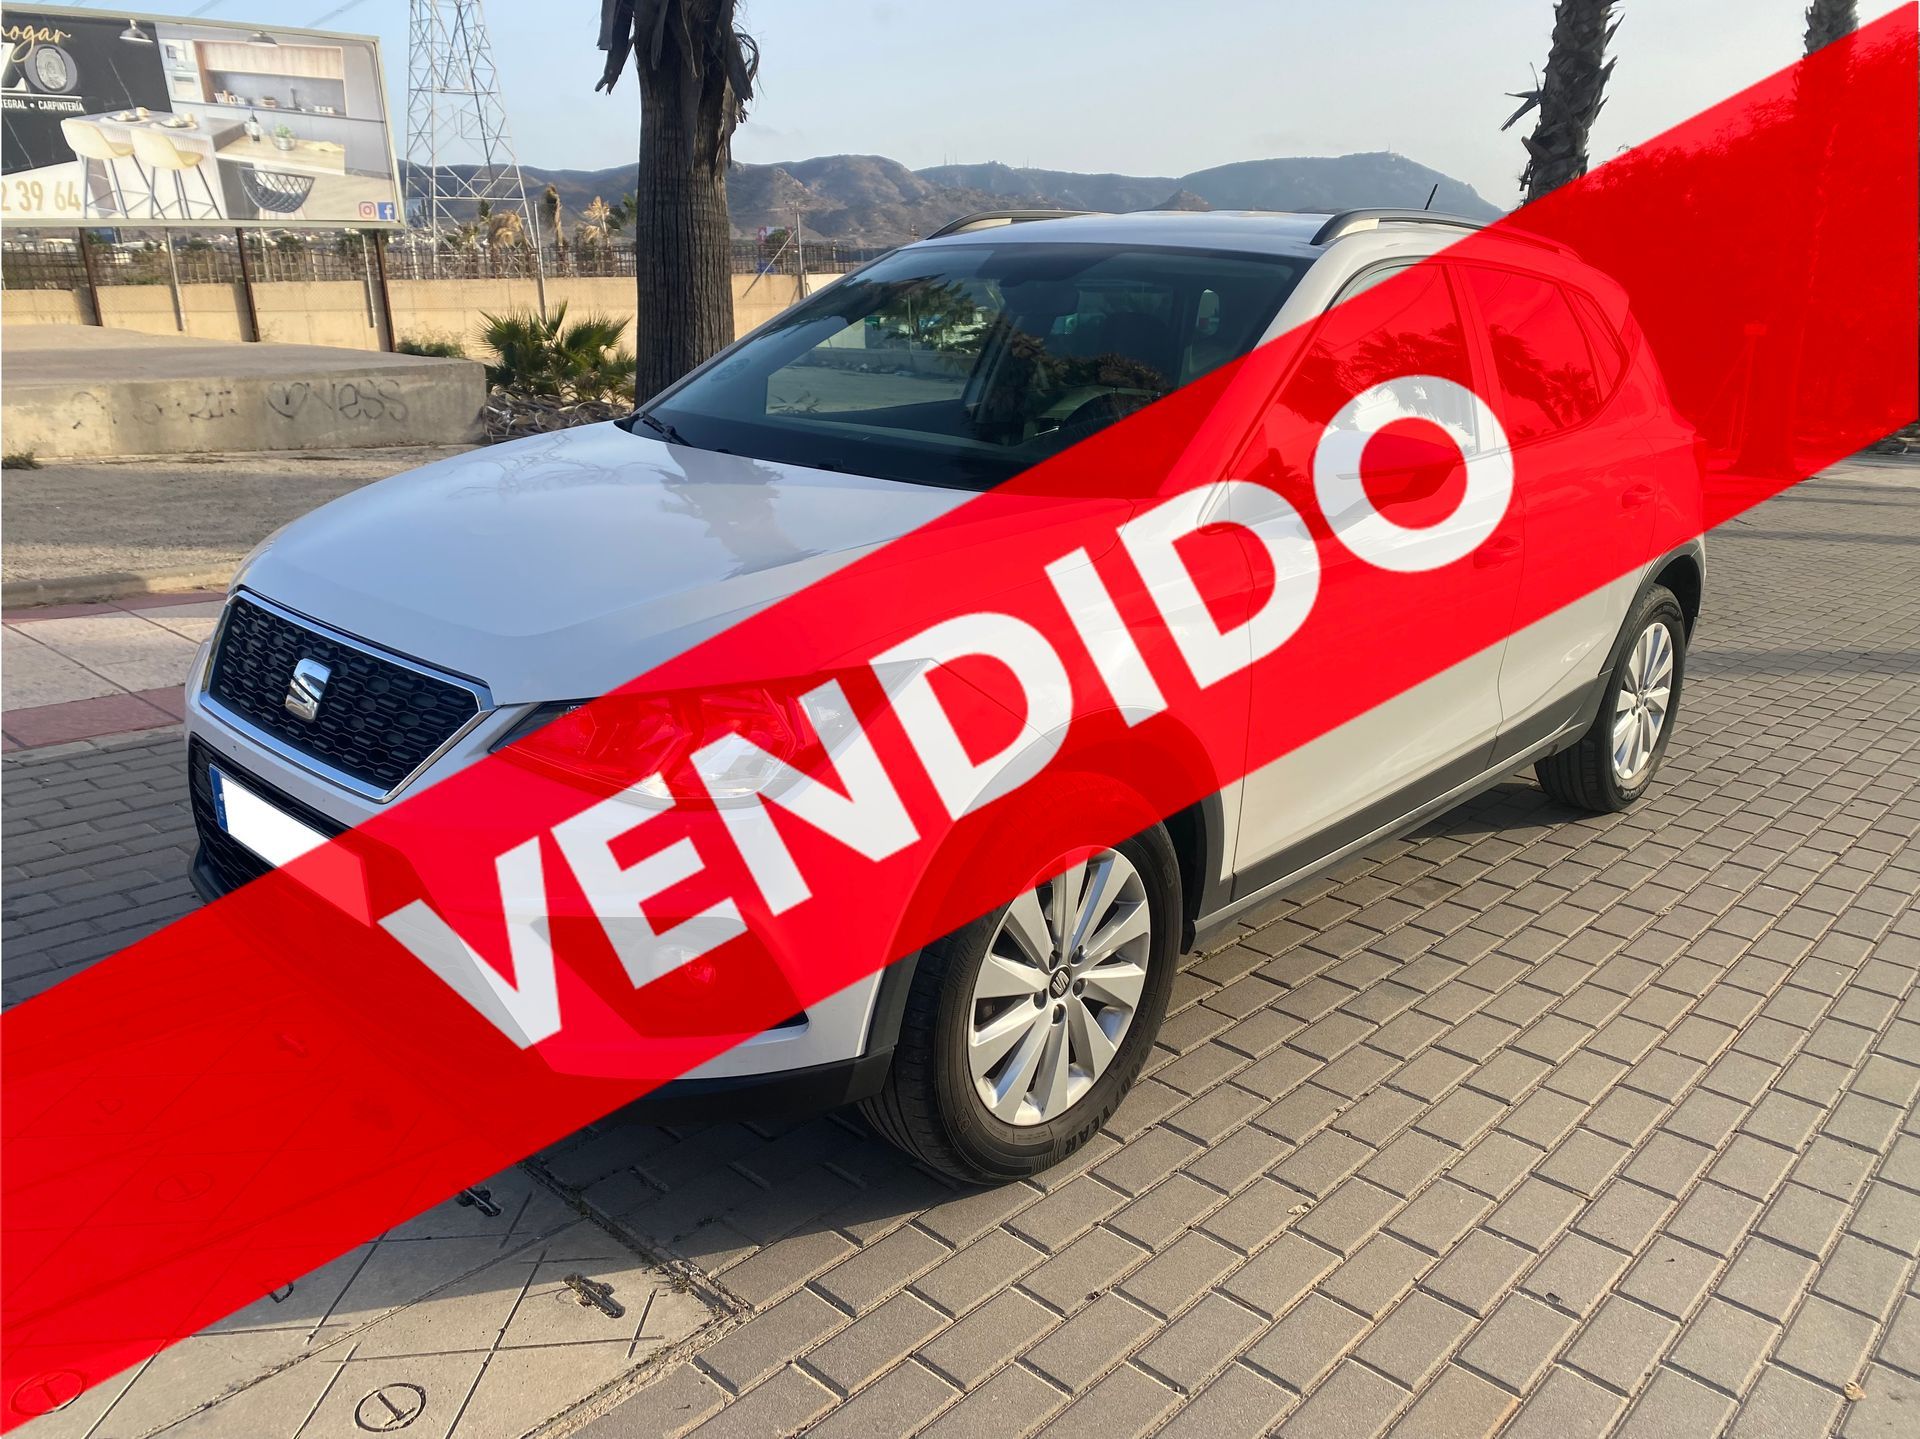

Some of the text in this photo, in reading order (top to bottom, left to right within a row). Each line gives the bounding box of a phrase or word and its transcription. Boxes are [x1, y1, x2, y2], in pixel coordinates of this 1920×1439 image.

[38, 100, 86, 113] CARPINTERÍA
[16, 181, 43, 212] 39
[54, 181, 81, 212] 64
